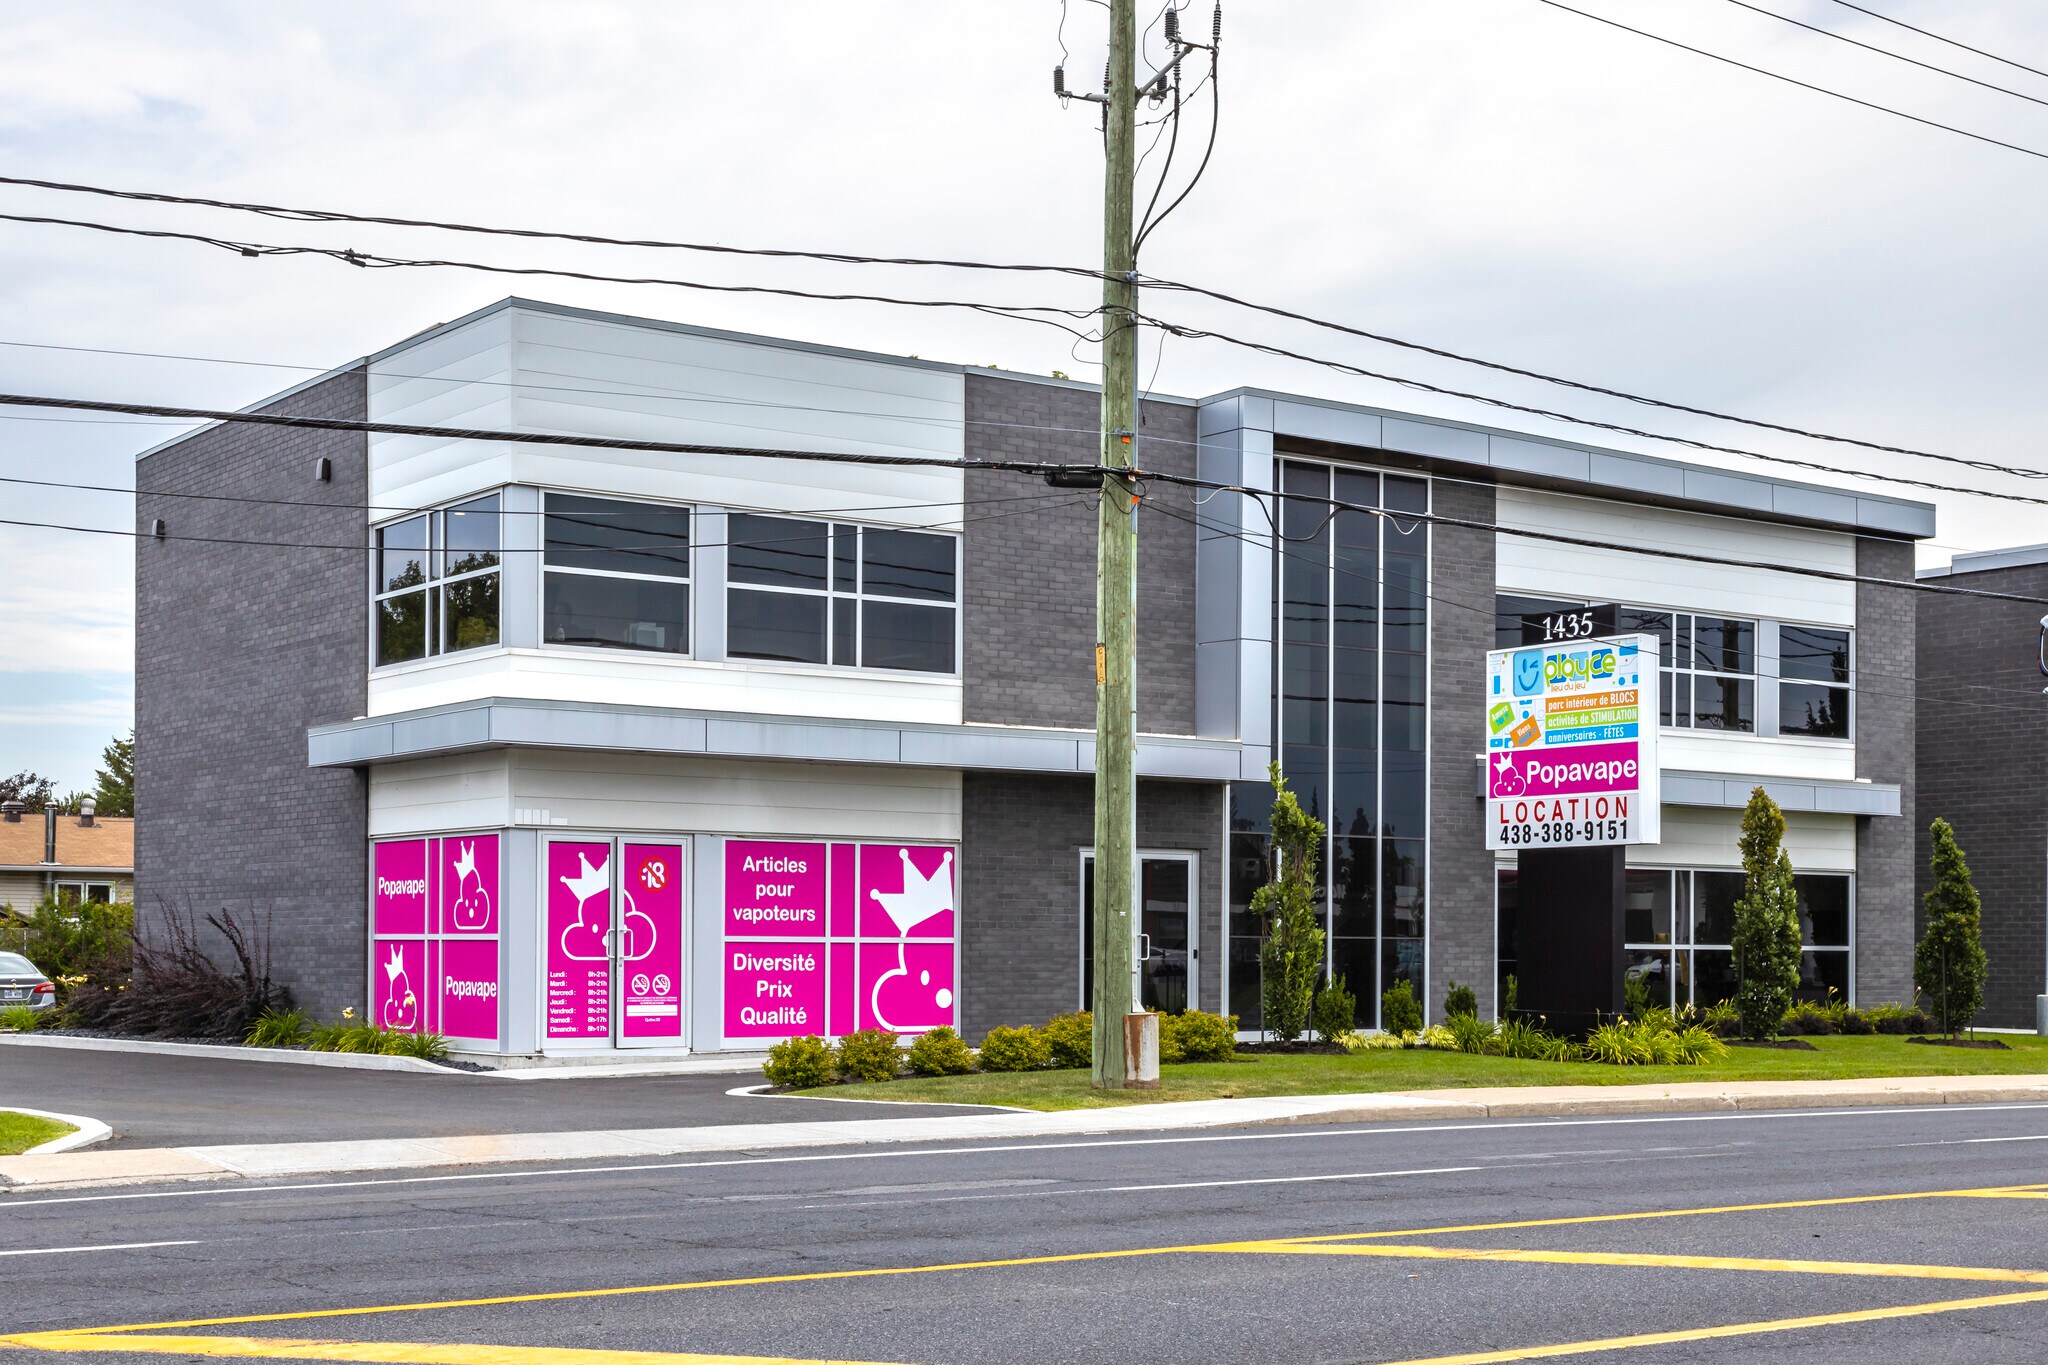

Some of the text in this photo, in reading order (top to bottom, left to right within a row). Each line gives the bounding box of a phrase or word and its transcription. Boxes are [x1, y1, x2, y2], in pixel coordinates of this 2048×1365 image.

[1542, 612, 1593, 641] 1435
[1544, 653, 1616, 687] playce
[1565, 682, 1574, 691] du
[1574, 682, 1586, 692] jeu
[1548, 691, 1635, 713] parc intérieur de BLOCS
[1548, 708, 1637, 727] activités de STIMULATION
[1548, 731, 1597, 743] anniversaires
[1603, 725, 1624, 738] FÊTES
[1526, 758, 1637, 788] Popavape
[1500, 796, 1628, 824] LOCATION
[1500, 819, 1628, 845] 438-388-9151
[742, 855, 807, 874] Articles
[378, 876, 425, 899] Popavape
[755, 883, 795, 900] pour
[733, 905, 816, 924] vapoteurs
[733, 953, 816, 971] Diversité
[445, 975, 497, 1002] Popavape
[756, 980, 792, 998] Prix
[740, 1006, 807, 1025] Qualité
